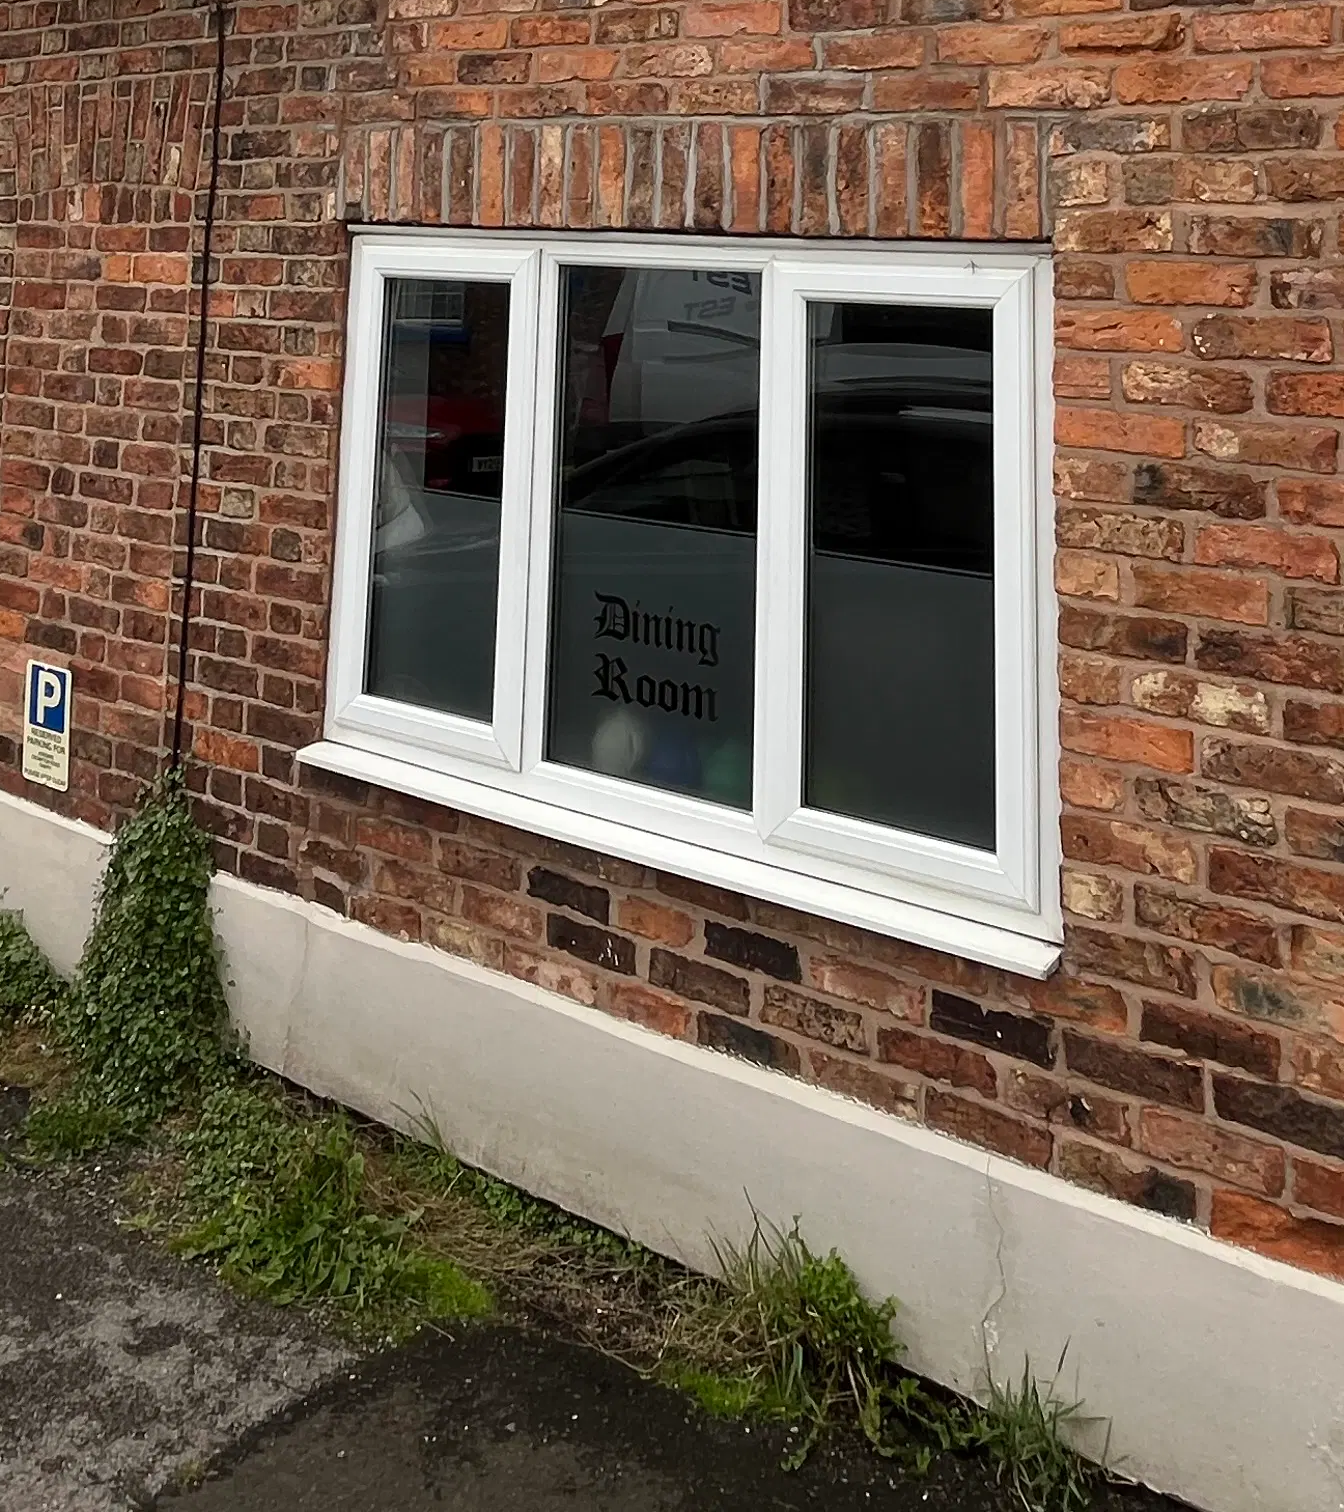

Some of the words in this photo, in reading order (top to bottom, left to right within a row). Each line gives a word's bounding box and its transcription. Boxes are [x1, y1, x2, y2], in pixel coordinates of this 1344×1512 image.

[593, 590, 721, 667] Dining
[36, 669, 62, 724] P
[591, 652, 719, 722] Room
